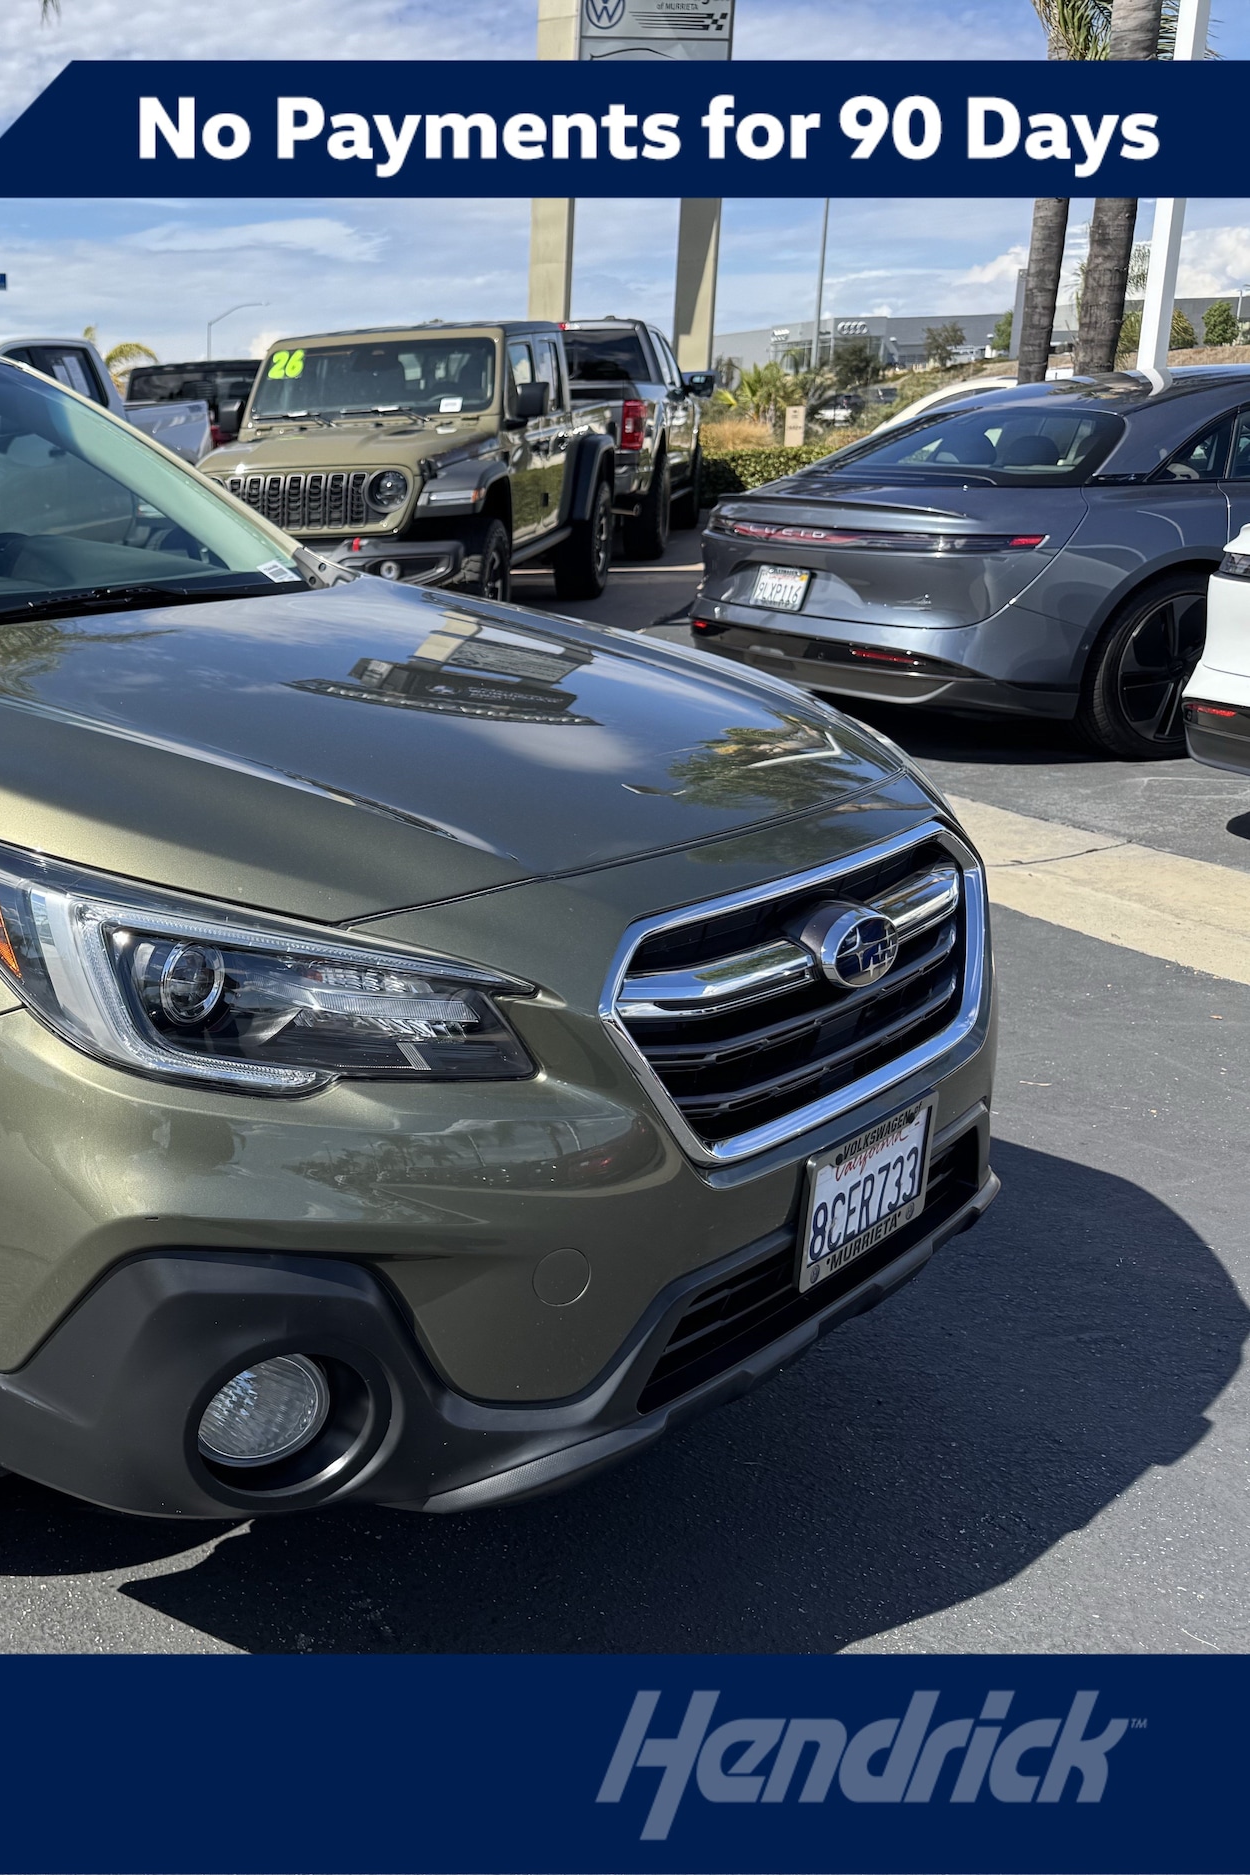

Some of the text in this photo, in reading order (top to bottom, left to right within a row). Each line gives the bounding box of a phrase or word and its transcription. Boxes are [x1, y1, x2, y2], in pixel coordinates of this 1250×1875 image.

[267, 349, 305, 380] 26
[749, 525, 826, 538] LUCID
[842, 1113, 912, 1160] VOLKSWAGEN
[809, 1146, 919, 1261] 8CER733
[829, 1216, 898, 1272] MURRIETA
